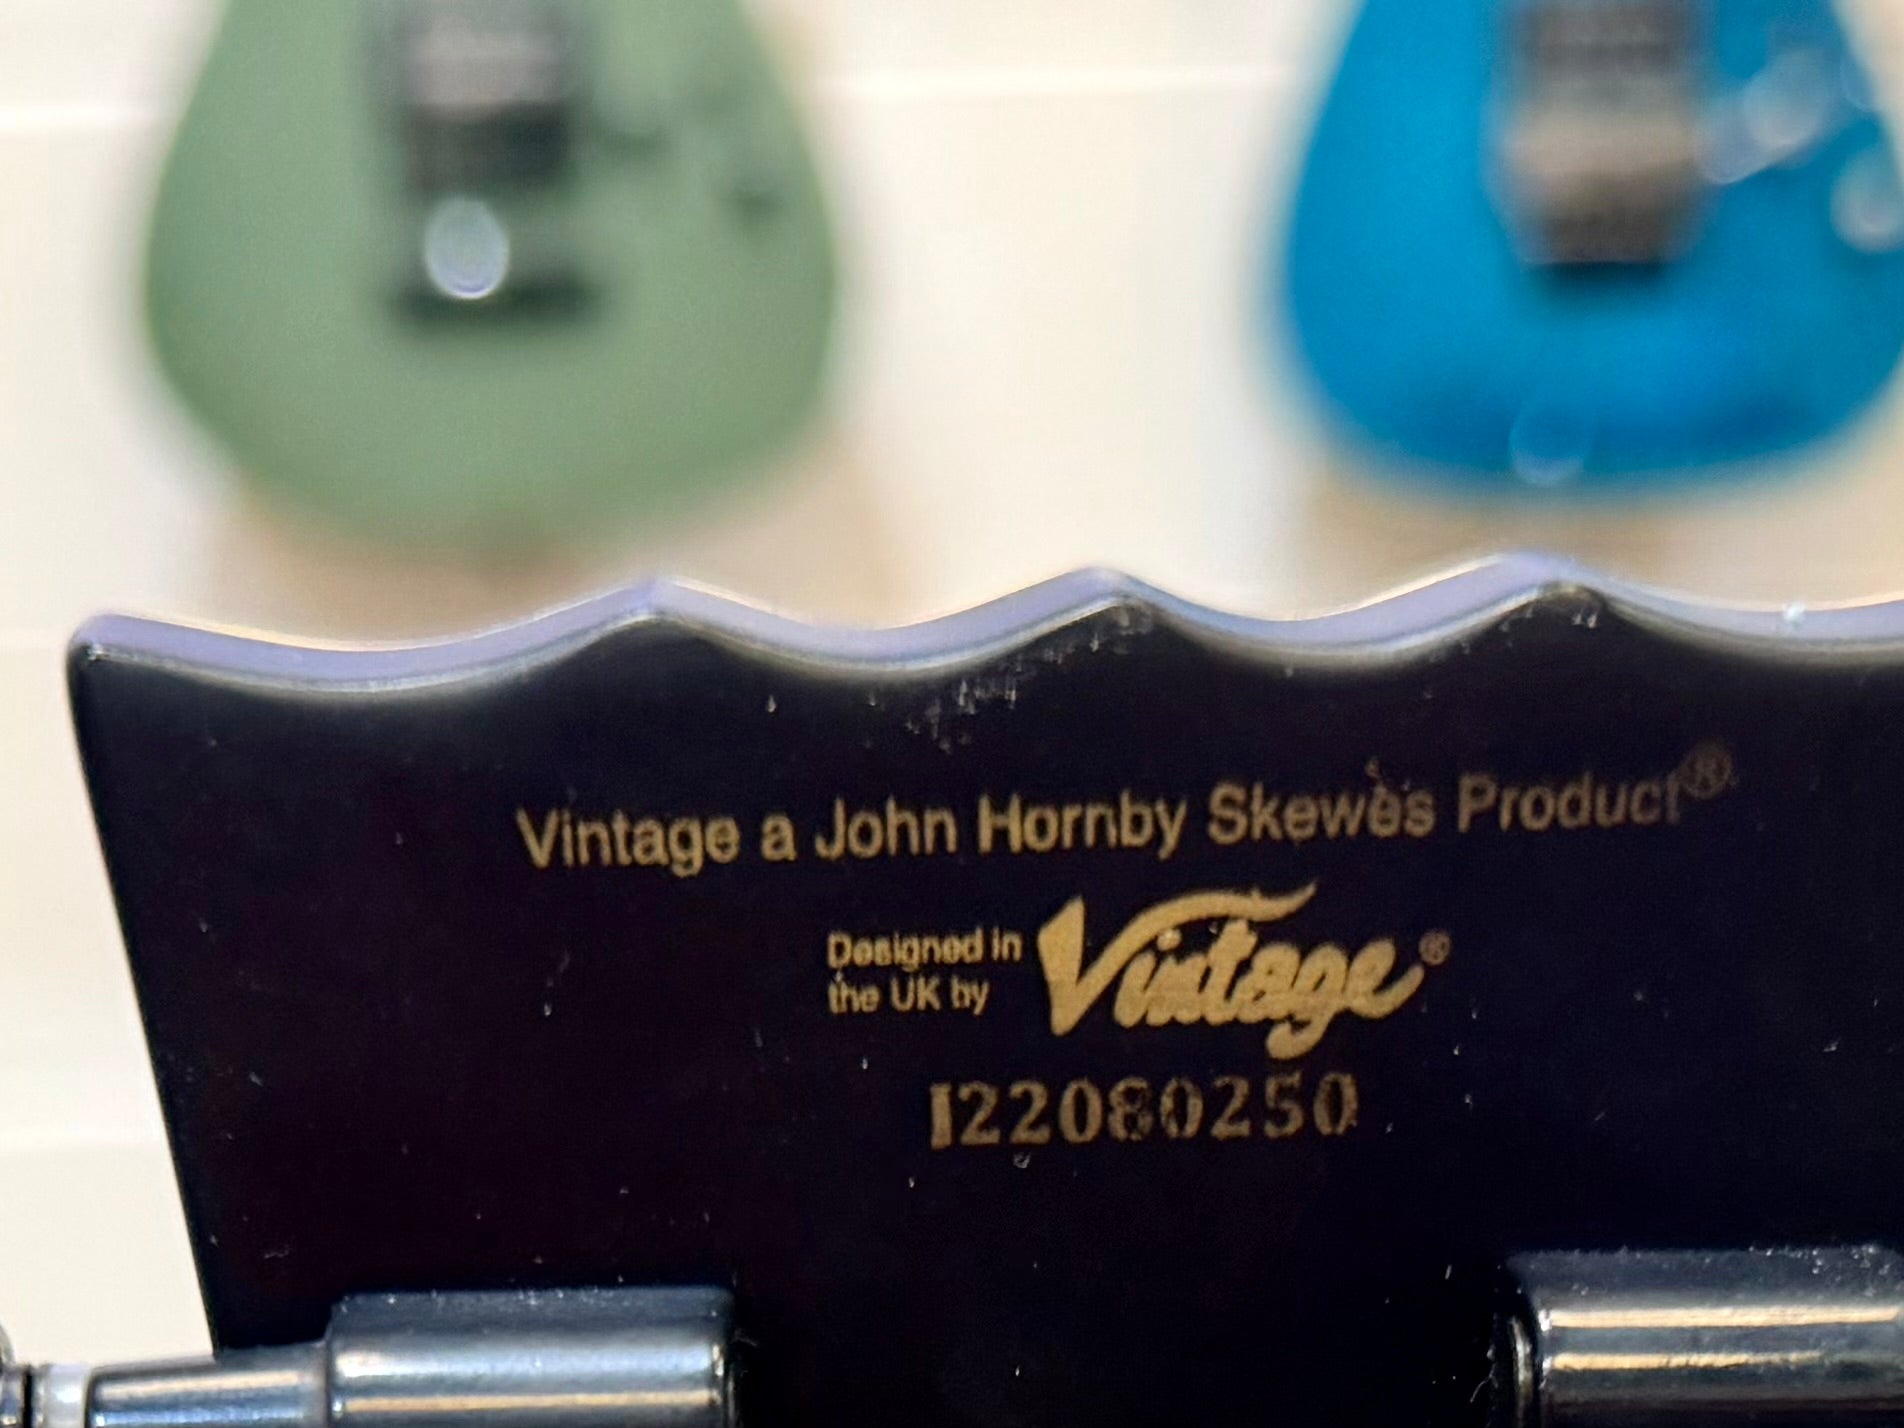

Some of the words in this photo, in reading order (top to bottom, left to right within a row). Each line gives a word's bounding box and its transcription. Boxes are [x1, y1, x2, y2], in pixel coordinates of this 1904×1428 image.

[515, 807, 741, 879] Vintage
[760, 812, 797, 862] a
[814, 795, 958, 861] John
[977, 789, 1189, 861] Hornby
[1207, 779, 1436, 846] Skewes
[827, 926, 984, 973] Designed
[991, 926, 1024, 962] in
[827, 973, 881, 1014] the
[890, 974, 942, 1012] UK
[950, 974, 990, 1016] by
